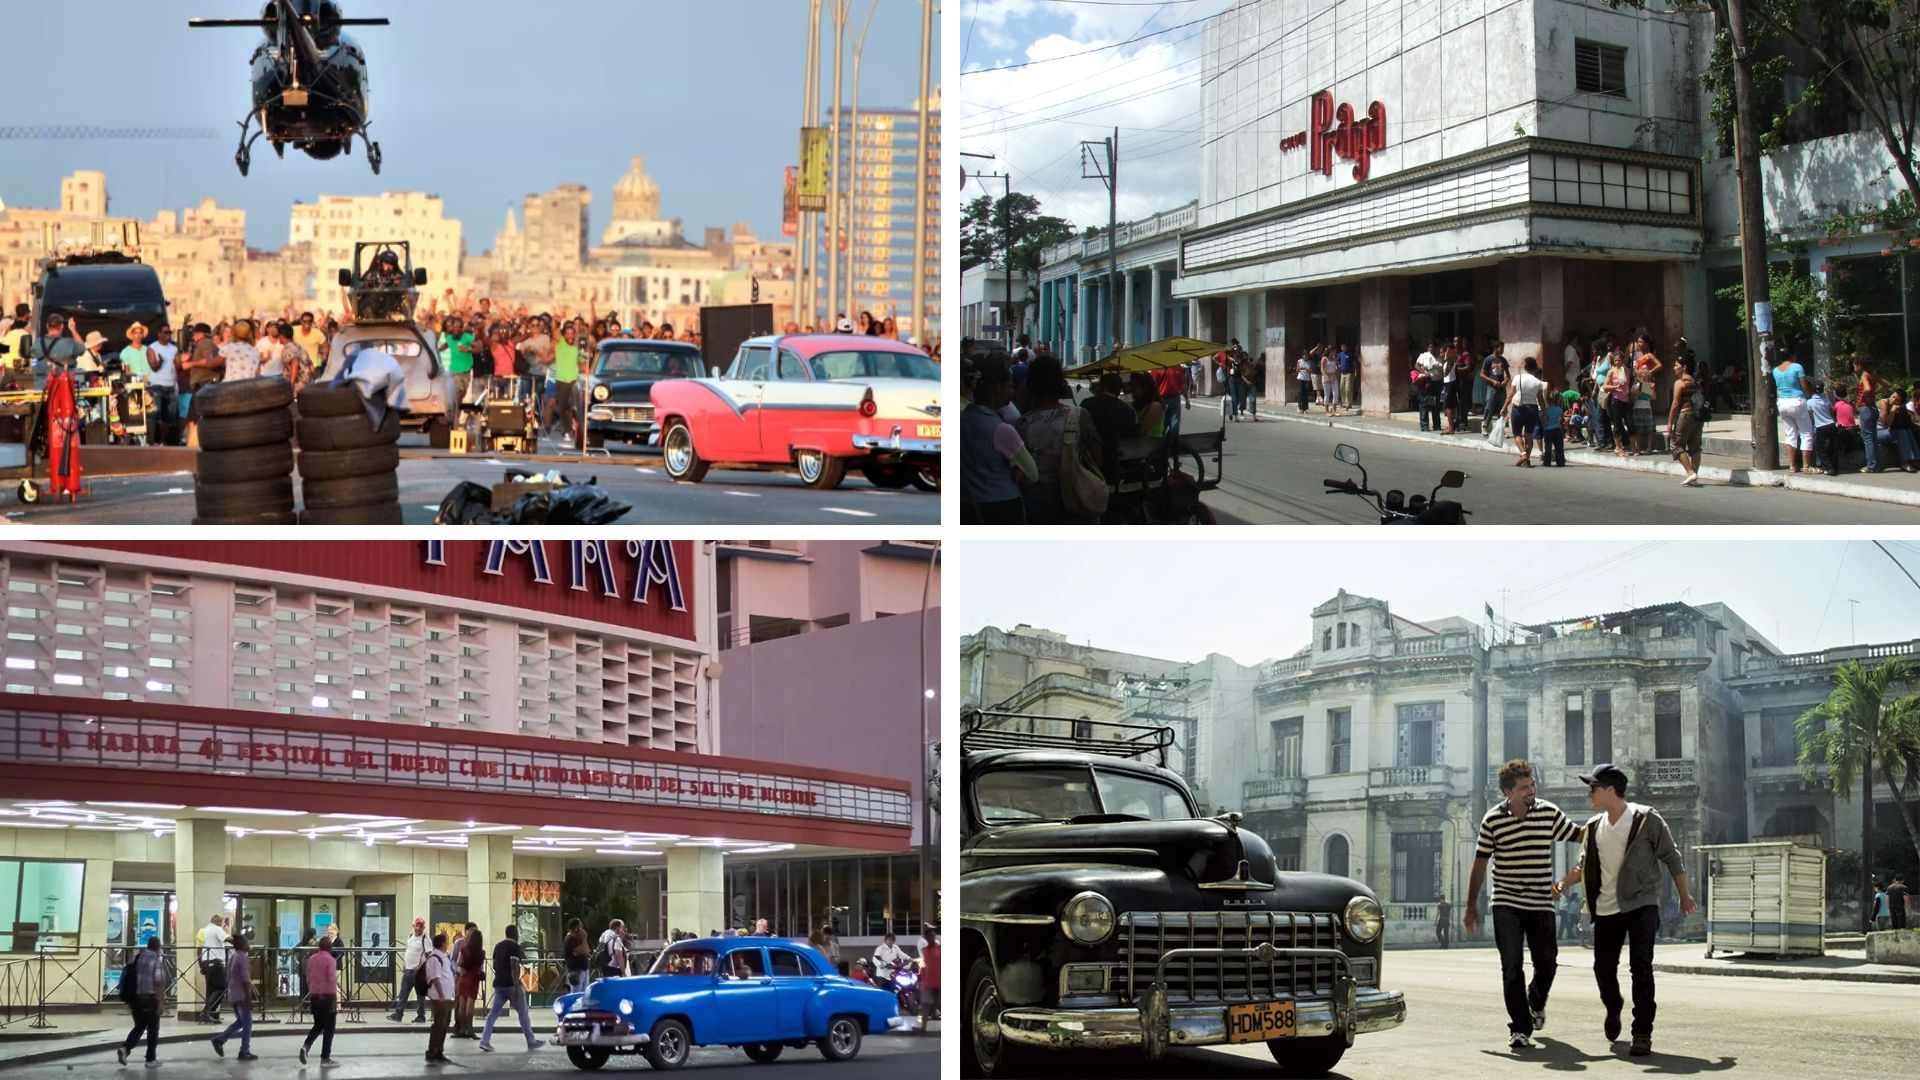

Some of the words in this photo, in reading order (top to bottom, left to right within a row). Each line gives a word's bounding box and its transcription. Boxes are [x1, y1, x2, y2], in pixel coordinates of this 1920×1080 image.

[1311, 89, 1386, 182] Praga
[39, 728, 71, 750] LA
[87, 731, 180, 755] HABANA
[237, 741, 336, 767] FESTIVAL
[344, 749, 378, 770] DEL
[390, 753, 449, 774] NUEVO
[459, 758, 500, 779] CINE
[511, 763, 652, 791] LATINOAMERICANO
[659, 776, 685, 794] DEL
[690, 780, 699, 795] 5
[702, 780, 718, 797] AL
[722, 782, 734, 798] 15
[739, 784, 754, 801] DE
[760, 786, 817, 807] DICIEMBRE
[1231, 1009, 1294, 1035] HDM588
